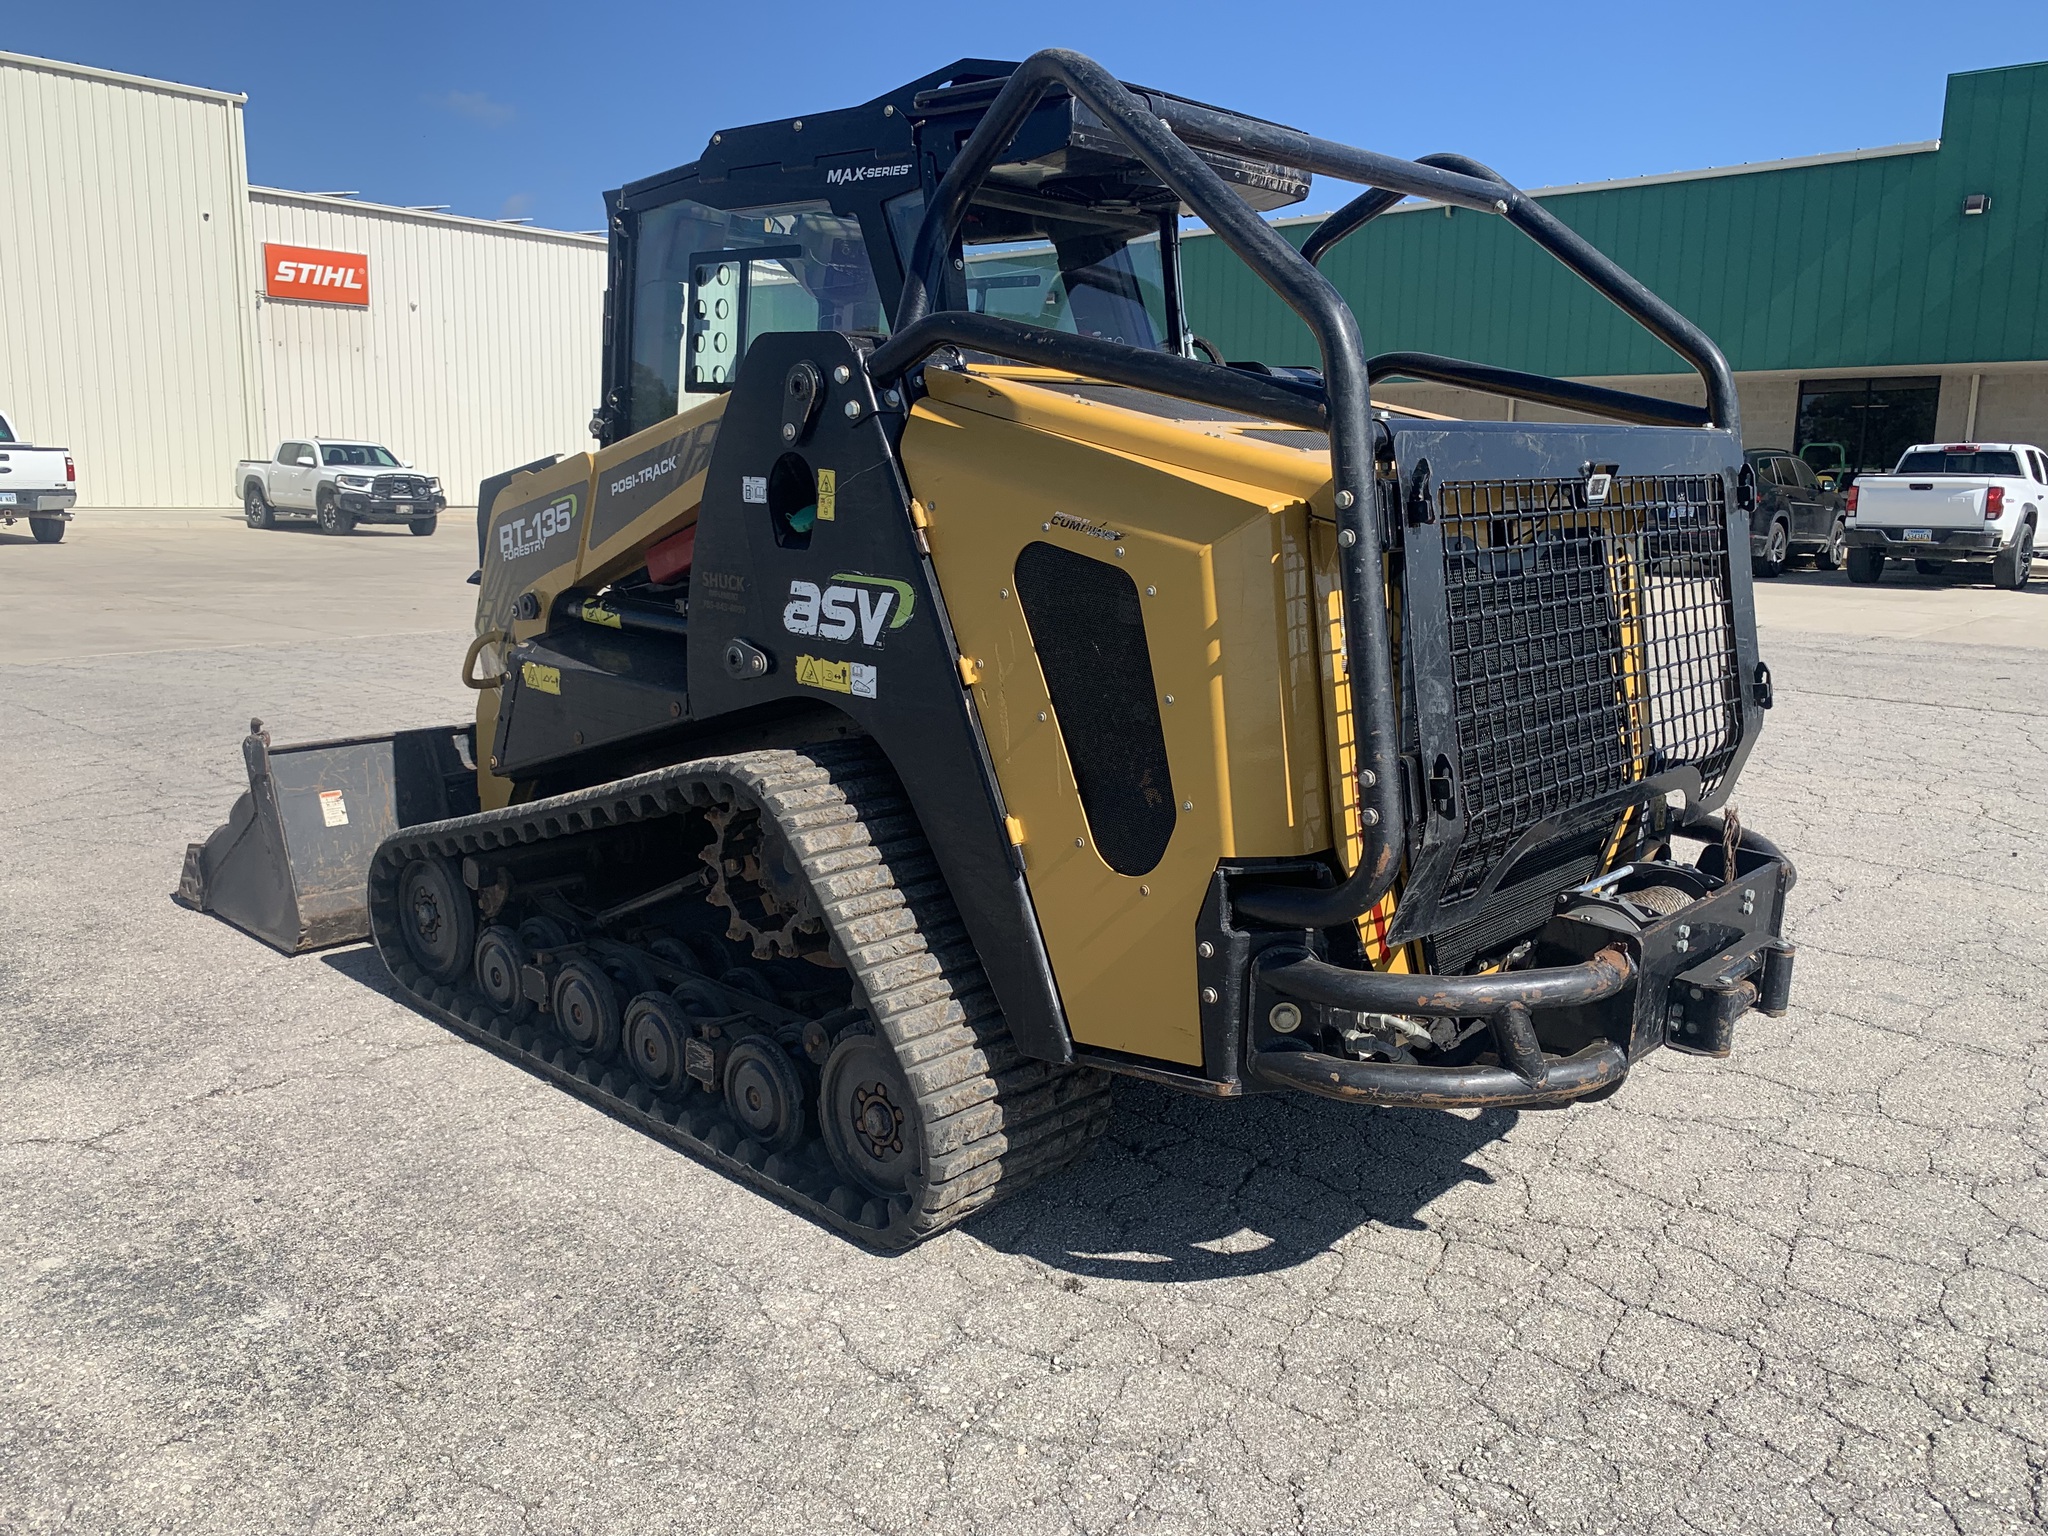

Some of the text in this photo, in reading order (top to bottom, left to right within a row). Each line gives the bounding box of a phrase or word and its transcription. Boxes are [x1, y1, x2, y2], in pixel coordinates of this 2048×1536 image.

[826, 164, 911, 186] MAX-SERIES
[274, 260, 363, 290] STIHL
[610, 456, 678, 497] POSI-TRACK
[499, 501, 571, 554] RT-135
[502, 537, 548, 562] FORESTRY
[702, 571, 746, 592] SHUCK
